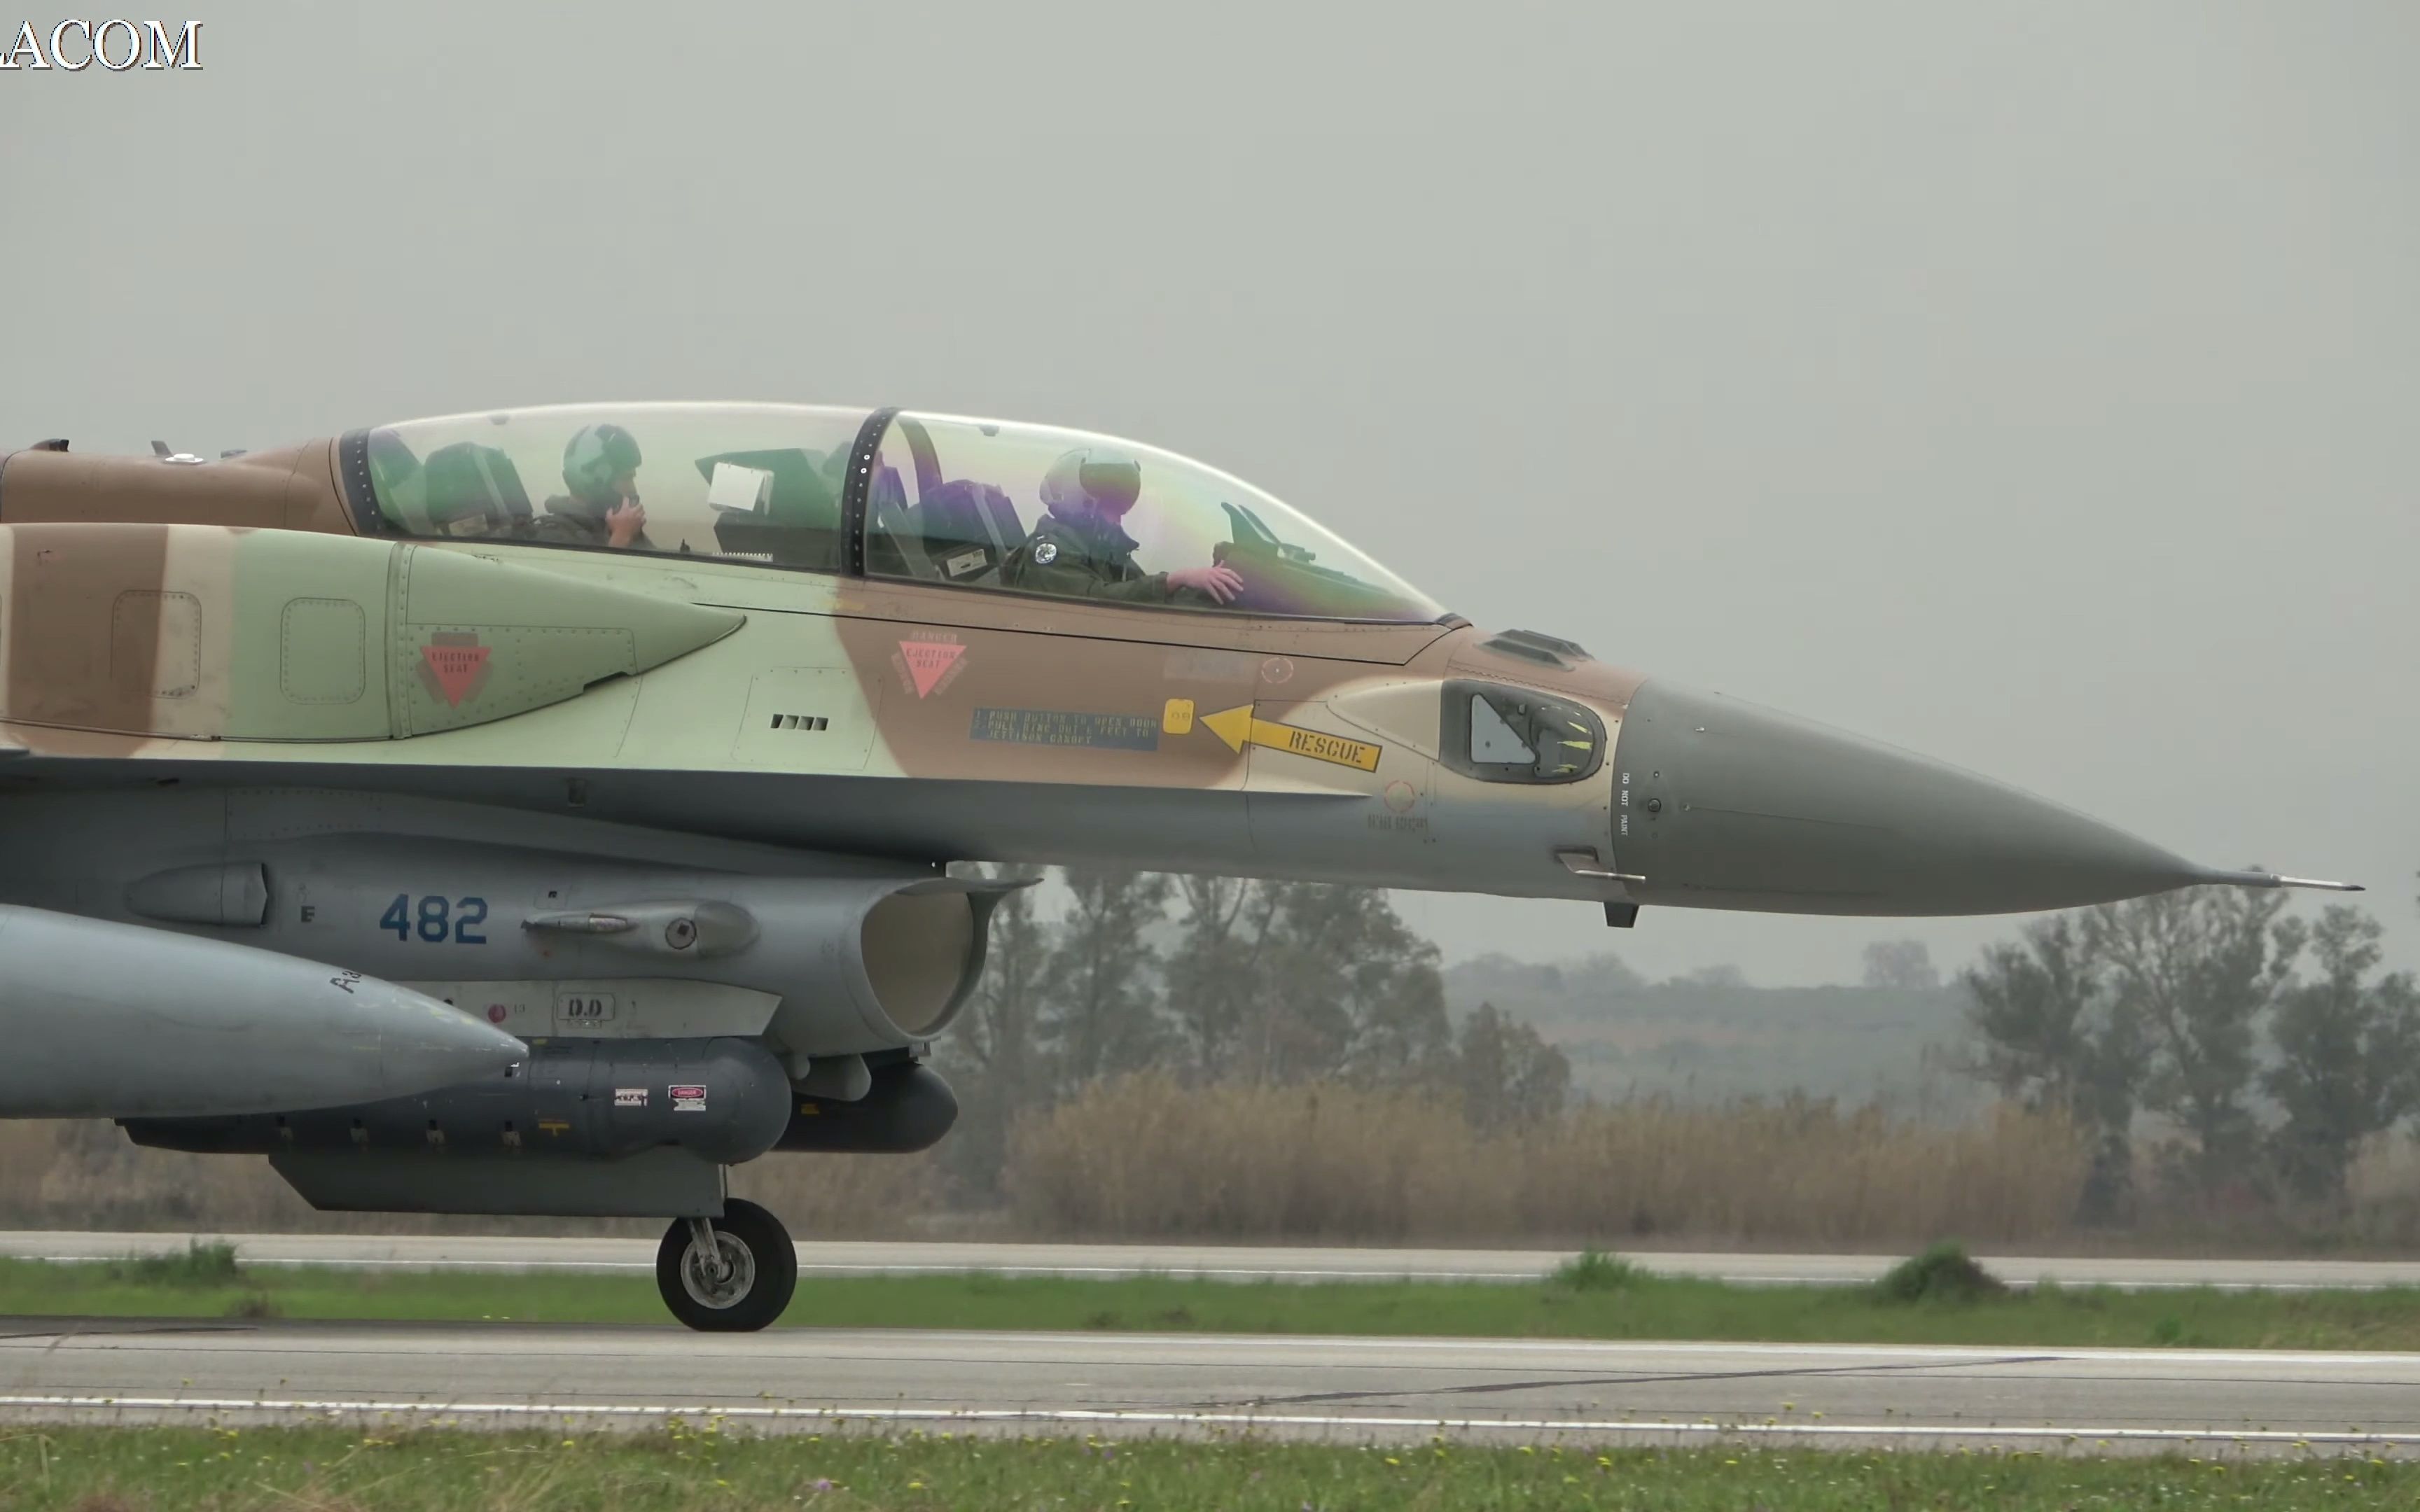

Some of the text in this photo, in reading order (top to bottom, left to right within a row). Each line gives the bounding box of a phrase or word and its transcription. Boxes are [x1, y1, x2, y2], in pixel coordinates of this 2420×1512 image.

[1288, 730, 1366, 764] RESCUE
[1620, 772, 1630, 836] DO NOT PAINT
[379, 893, 489, 945] 482
